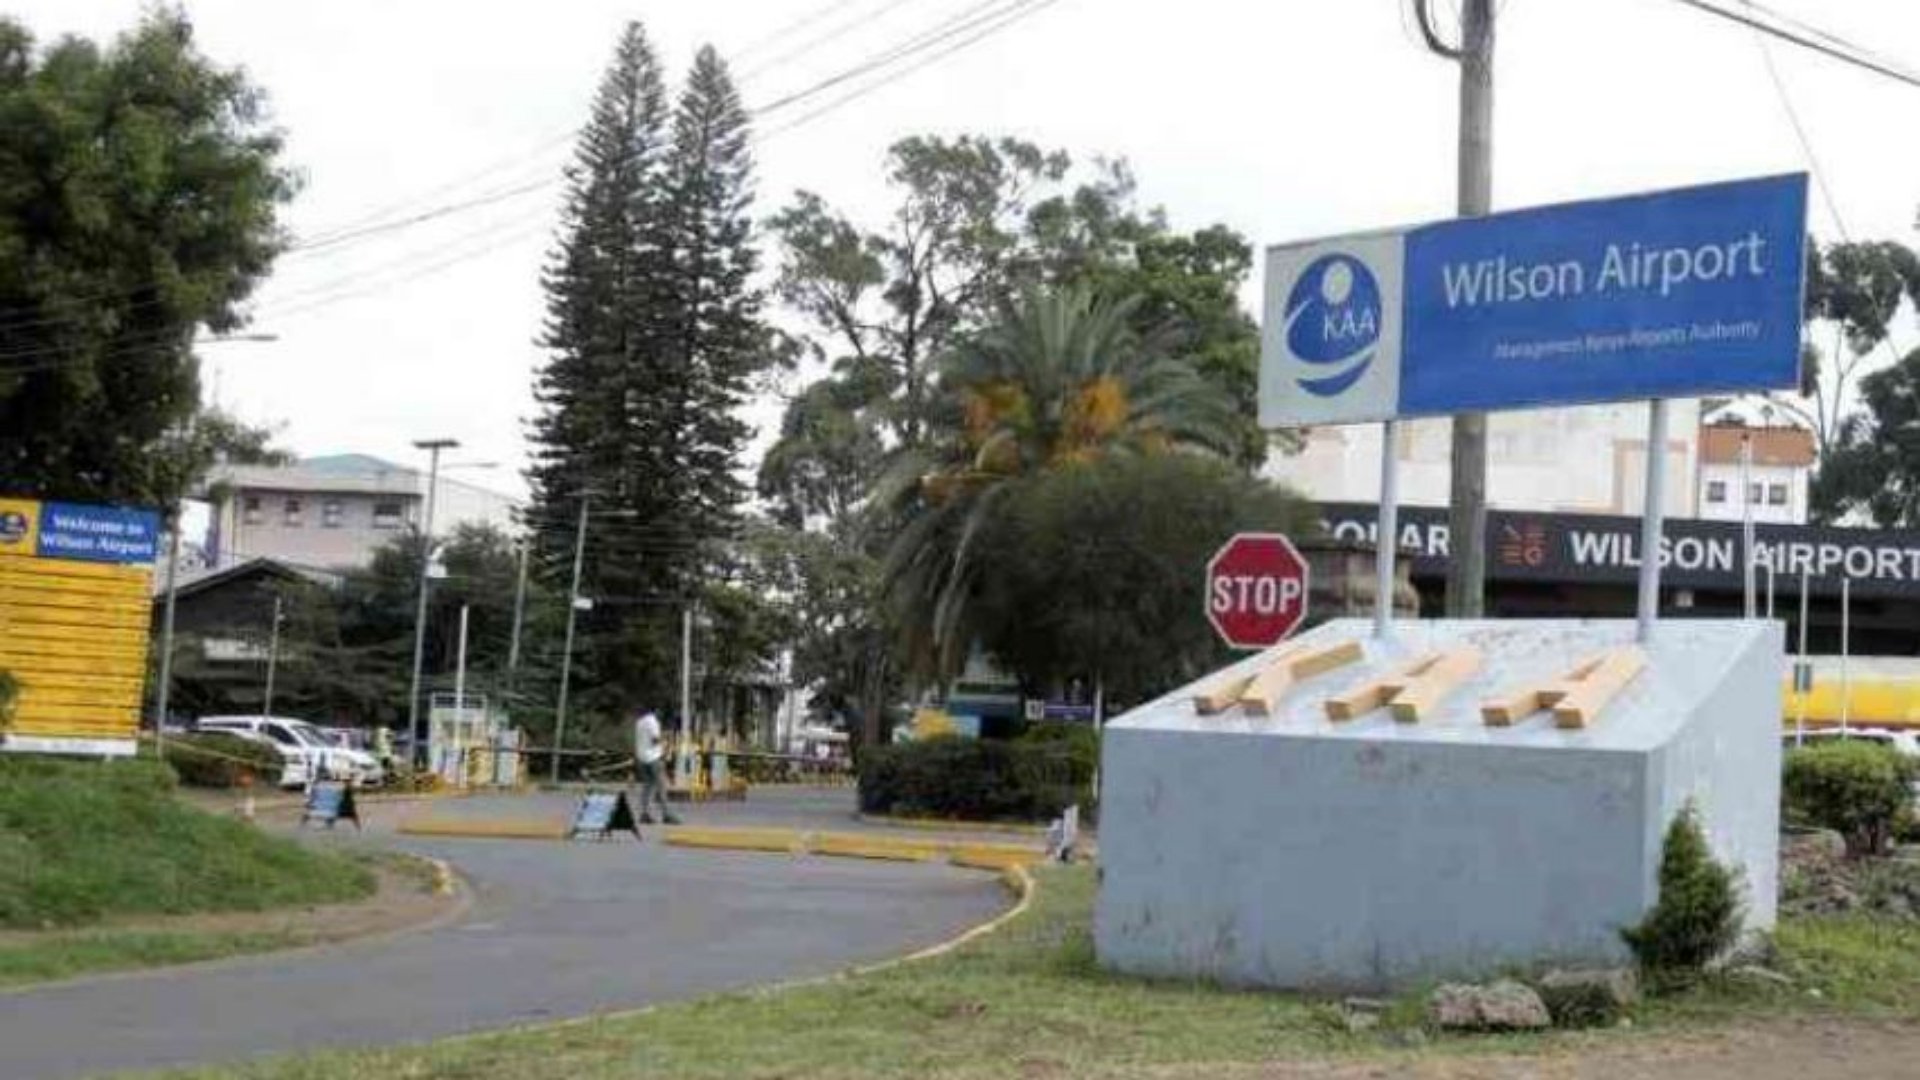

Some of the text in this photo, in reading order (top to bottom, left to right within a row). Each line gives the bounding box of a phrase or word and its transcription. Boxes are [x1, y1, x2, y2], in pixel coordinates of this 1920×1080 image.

[1442, 231, 1766, 309] Wilson Airport
[1324, 306, 1376, 342] KAA
[52, 513, 124, 534] Welcome
[40, 532, 153, 555] Wilson Airport
[1570, 530, 1733, 571] WILSON
[1750, 538, 1920, 580] AIRPORT
[1213, 576, 1301, 614] STOP
